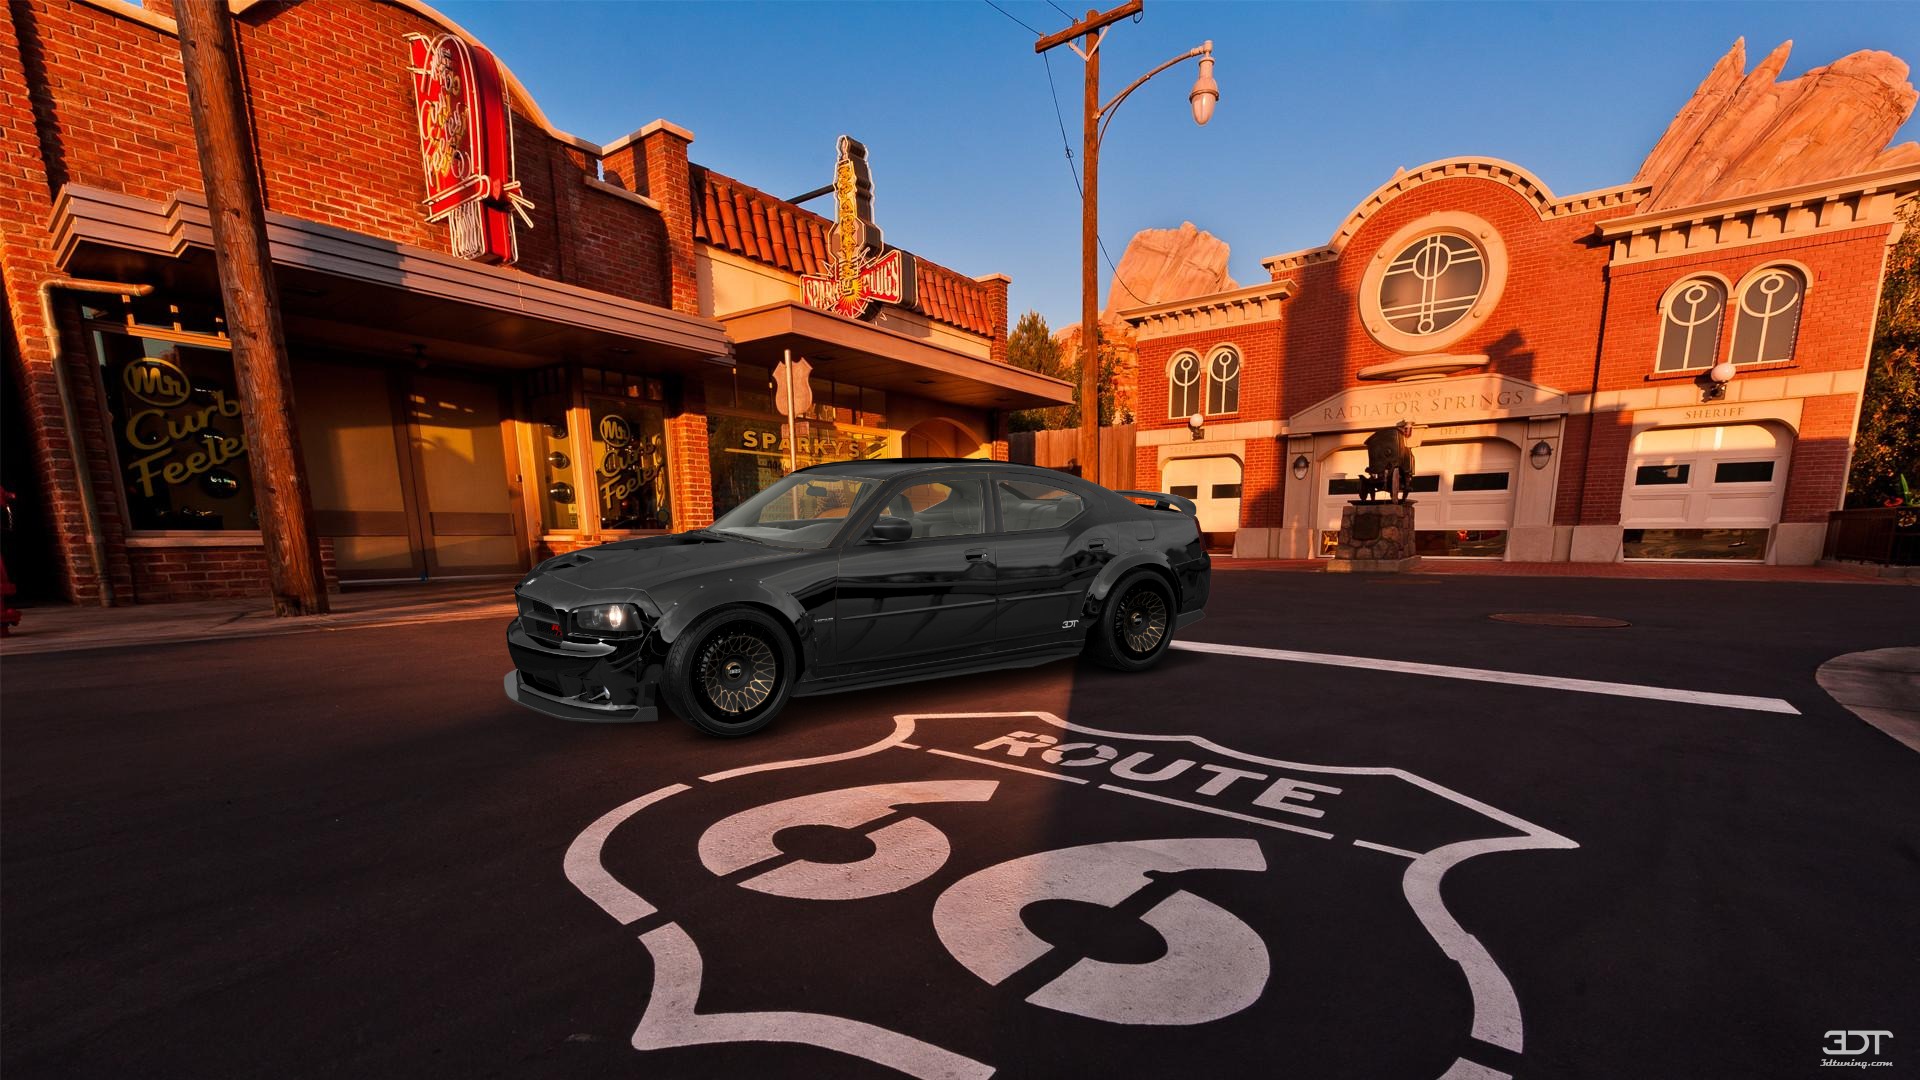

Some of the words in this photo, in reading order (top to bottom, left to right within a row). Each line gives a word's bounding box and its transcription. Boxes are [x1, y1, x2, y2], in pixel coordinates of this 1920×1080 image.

[806, 280, 840, 310] SPARK
[863, 257, 899, 297] PLUGS
[129, 365, 185, 399] Mr
[1390, 392, 1421, 401] TOWN
[1428, 388, 1442, 398] OF
[126, 390, 241, 450] Curb
[1323, 400, 1420, 421] RADIATOR
[1431, 390, 1524, 412] SPRINGS
[1685, 407, 1745, 419] SHERIFF
[974, 731, 1343, 818] ROUTE
[698, 779, 1270, 1026] 66
